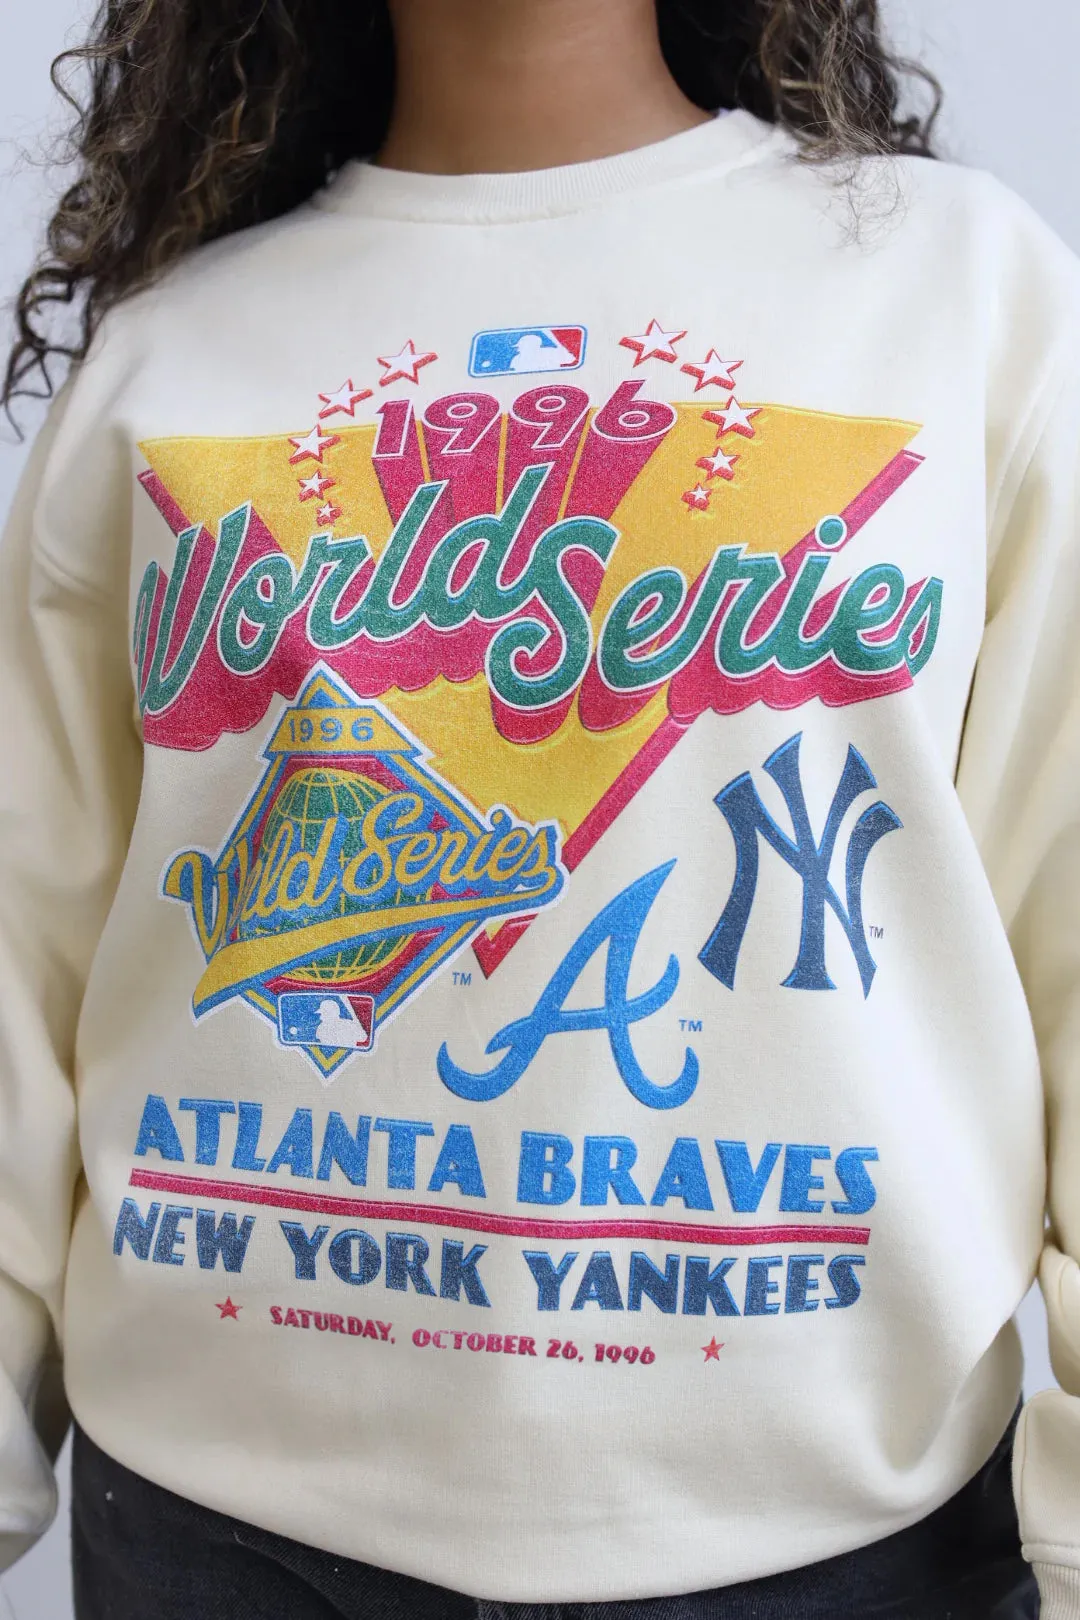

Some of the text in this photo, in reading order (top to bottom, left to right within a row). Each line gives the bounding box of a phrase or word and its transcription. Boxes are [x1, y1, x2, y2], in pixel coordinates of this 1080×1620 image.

[373, 380, 676, 459] 1996
[133, 462, 944, 717] World Series
[290, 717, 375, 743] 1996
[342, 791, 557, 897] Series
[697, 731, 903, 999] NY
[868, 926, 884, 939] TM
[437, 857, 701, 1110] A
[452, 972, 473, 986] TM
[680, 1019, 703, 1032] TM
[134, 1094, 879, 1216] ATLANTA BRAVES
[113, 1197, 867, 1316] NEW YORK YANKEES
[270, 1305, 656, 1365] SATURDAY, OCTOBER 26, 1996
